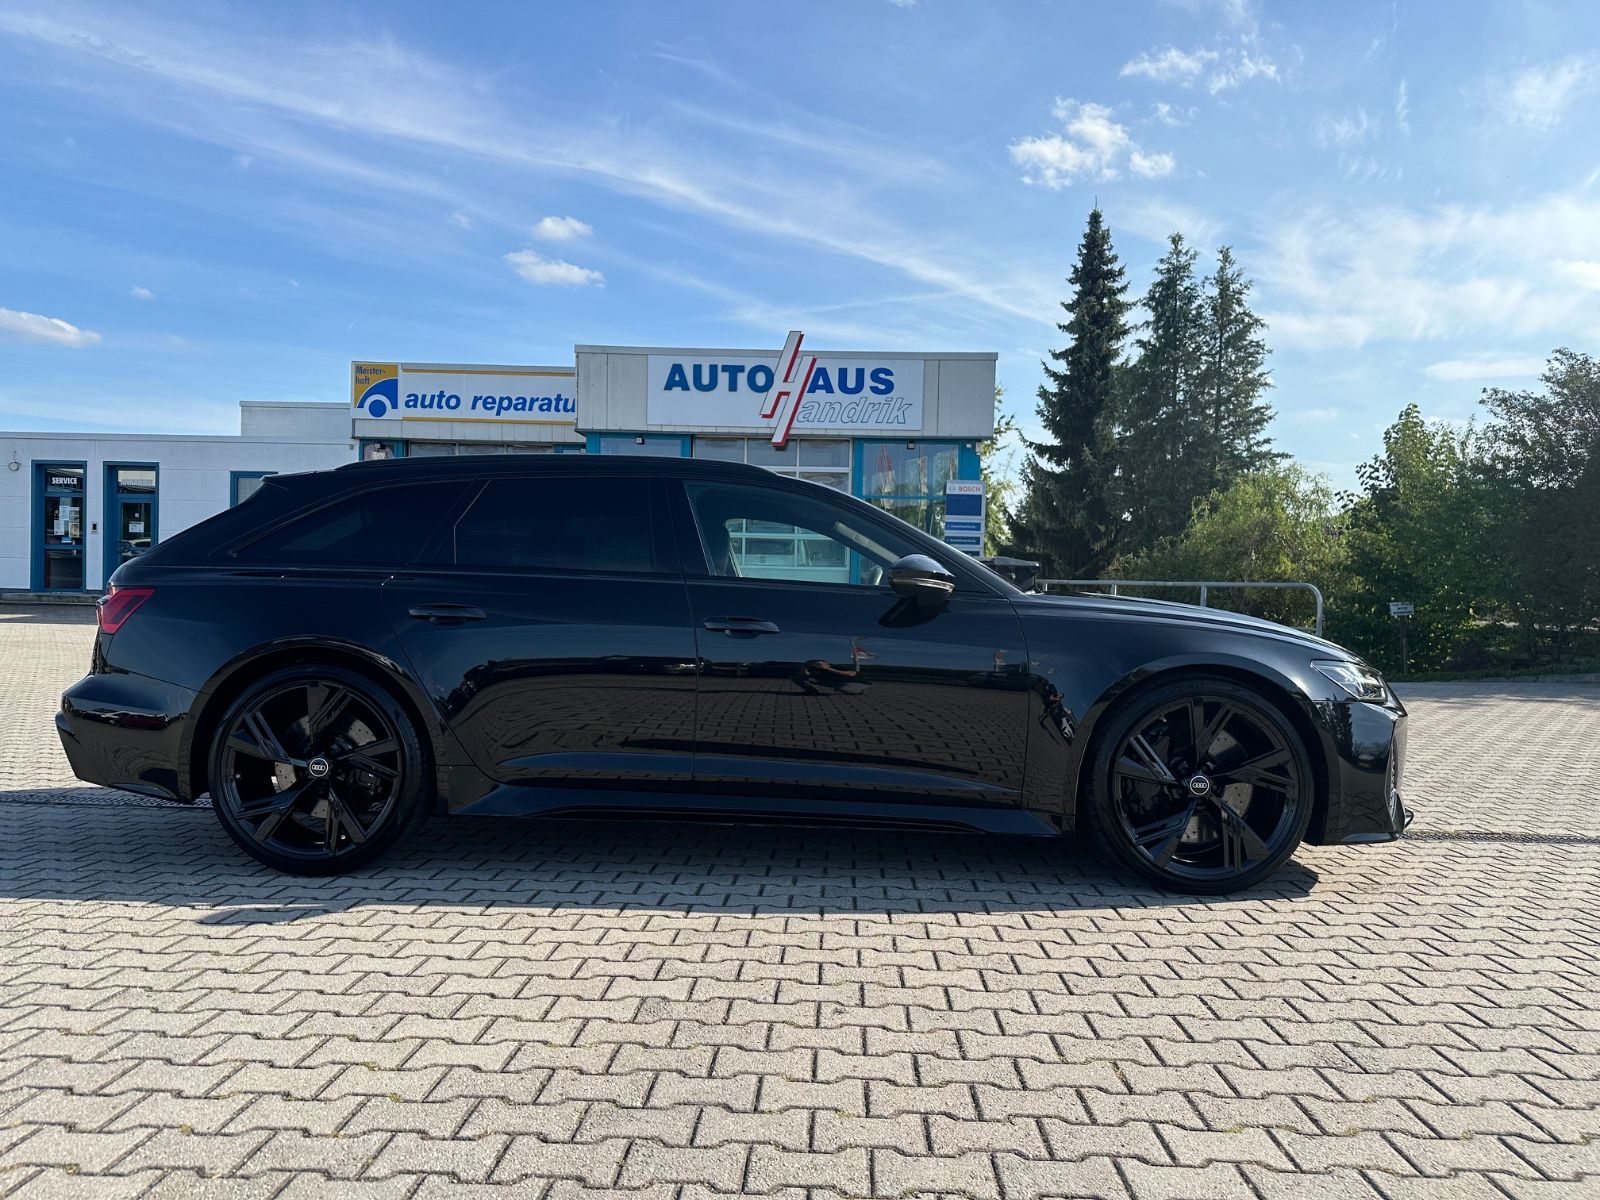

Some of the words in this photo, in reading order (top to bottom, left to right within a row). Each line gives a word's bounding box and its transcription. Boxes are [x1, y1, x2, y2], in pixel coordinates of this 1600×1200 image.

[355, 366, 386, 375] Meister-
[355, 376, 370, 385] haft
[404, 390, 461, 410] auto
[51, 477, 78, 485] SERVICE
